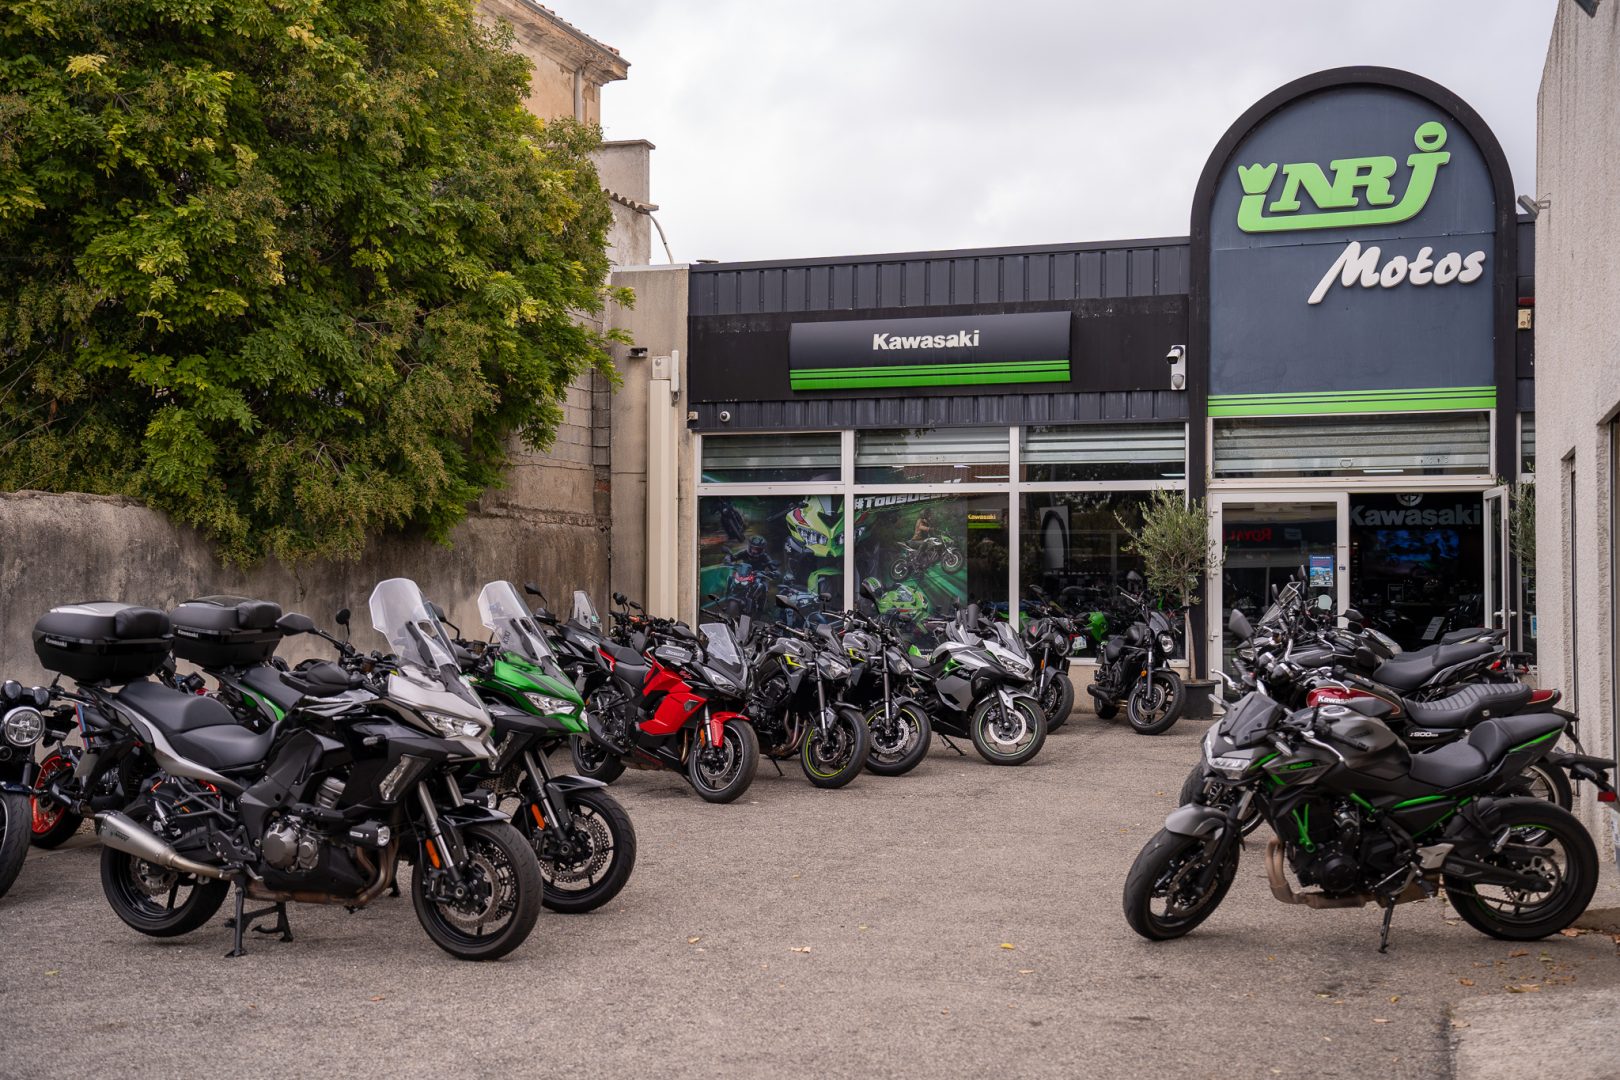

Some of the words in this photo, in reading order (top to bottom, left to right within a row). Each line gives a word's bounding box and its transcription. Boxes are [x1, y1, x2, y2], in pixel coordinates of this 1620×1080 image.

[1307, 241, 1486, 304] Motos
[872, 330, 979, 350] Kawasaki
[1349, 504, 1481, 526] Kawasaki
